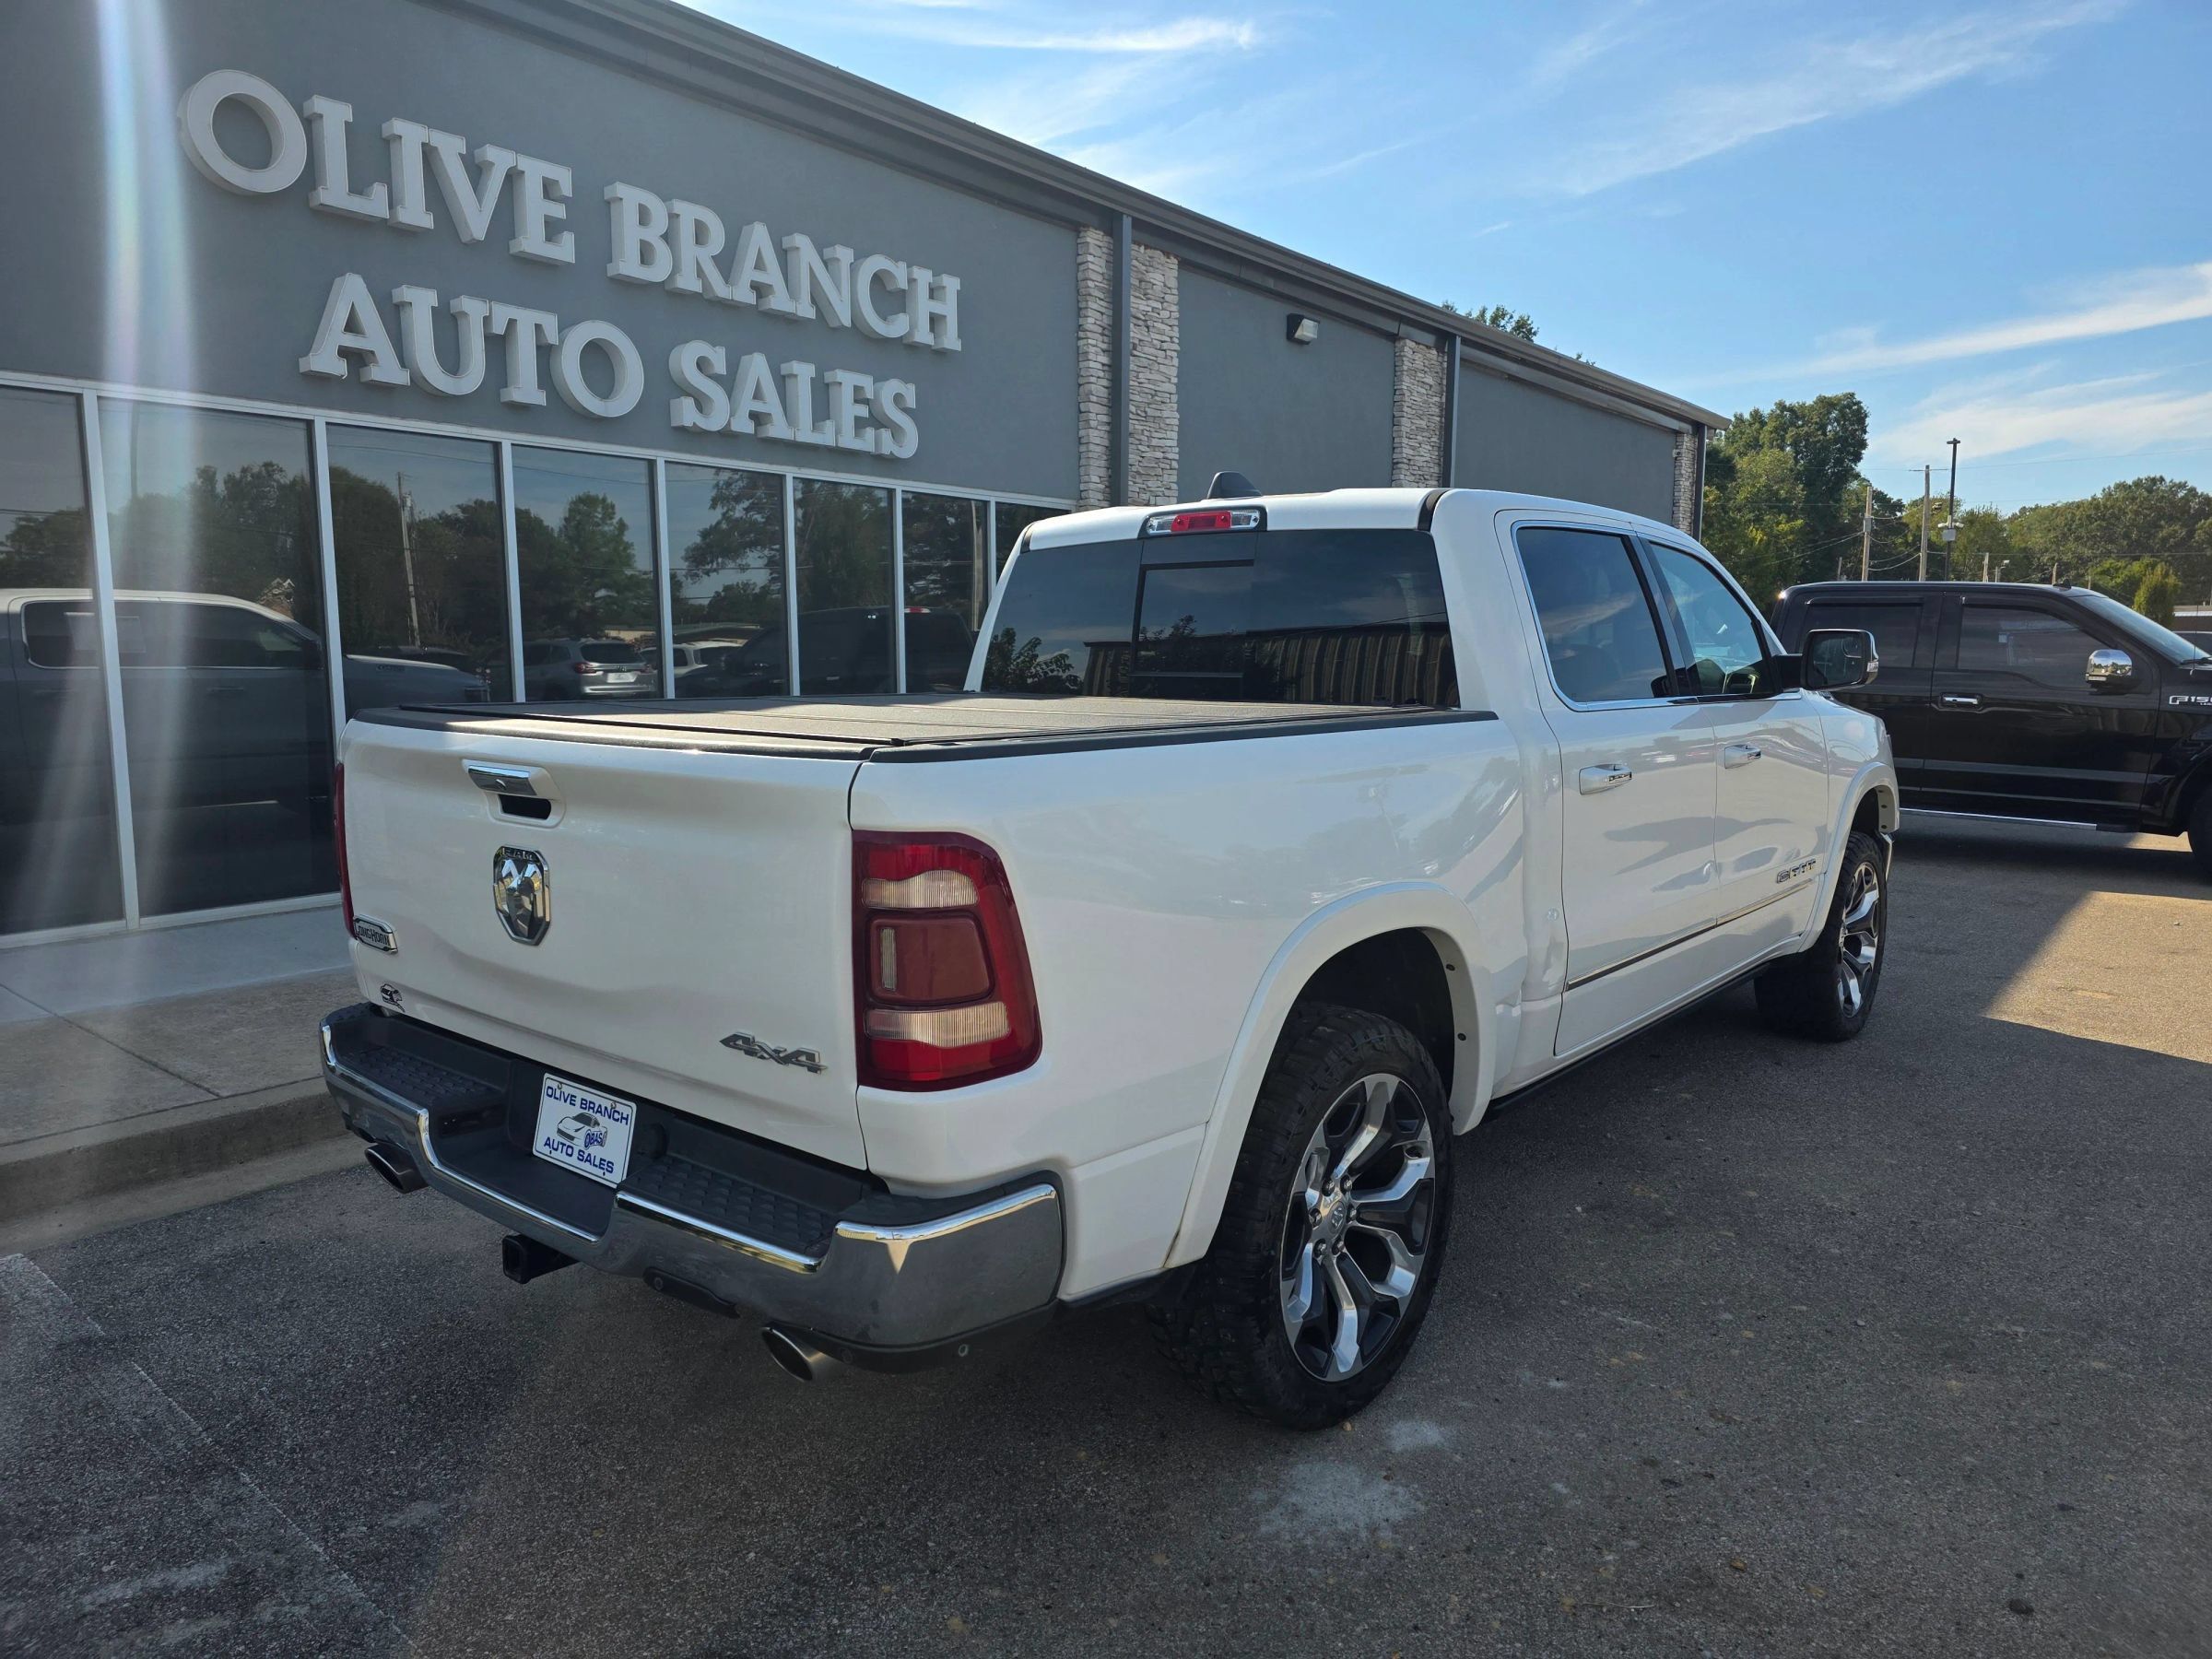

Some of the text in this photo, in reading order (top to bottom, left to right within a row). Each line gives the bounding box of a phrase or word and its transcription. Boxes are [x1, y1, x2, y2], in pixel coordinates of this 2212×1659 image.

[181, 69, 962, 352] OLIVE BRANCH
[299, 273, 919, 458] AUTO SALES
[2169, 695, 2212, 705] F15
[546, 1086, 629, 1125] OLIVE BRANCH
[544, 1136, 615, 1174] AUTO SALES
